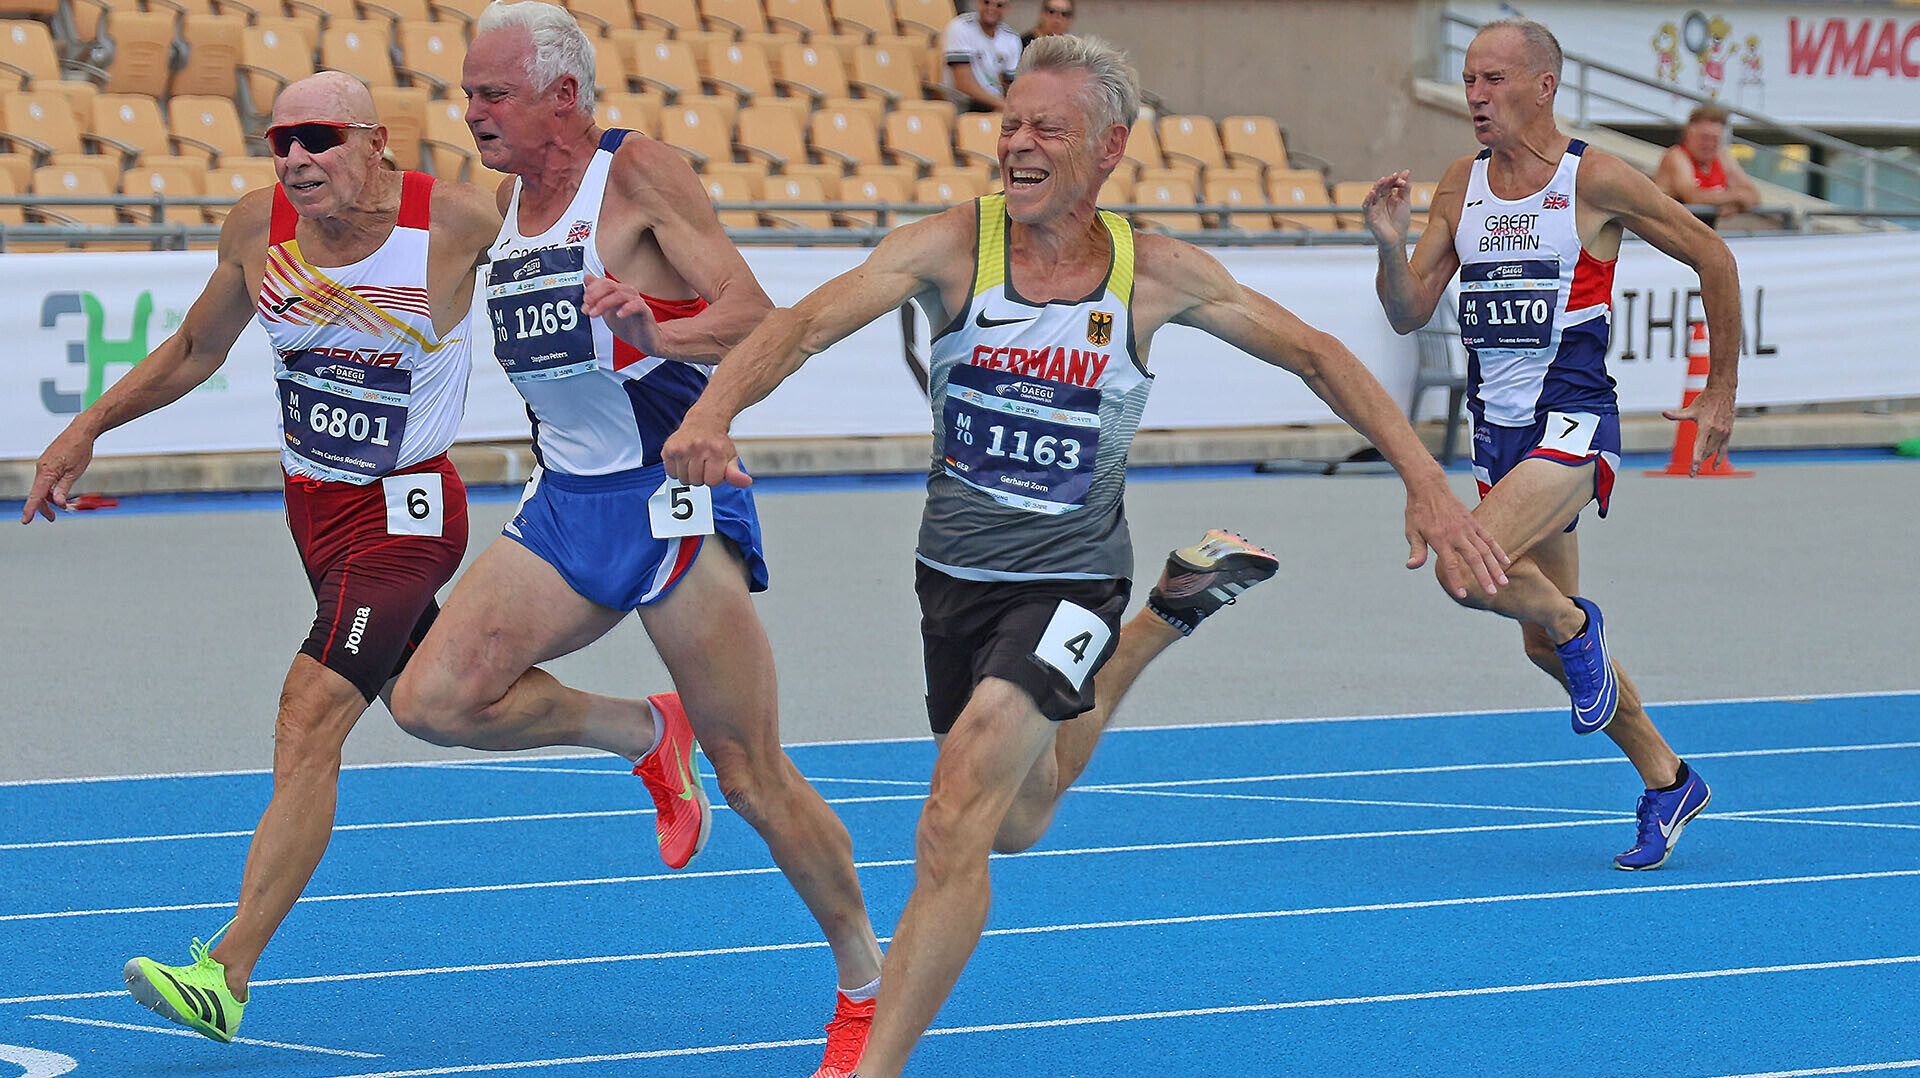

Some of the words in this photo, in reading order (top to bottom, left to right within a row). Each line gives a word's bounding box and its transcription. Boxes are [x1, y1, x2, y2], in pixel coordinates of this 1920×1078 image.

[1485, 214, 1539, 232] GREAT
[1479, 234, 1540, 252] BRITAIN
[1466, 299, 1477, 313] M
[1486, 299, 1548, 325] 1170
[515, 299, 578, 340] 1269
[1463, 313, 1479, 326] 70
[497, 326, 508, 342] 70
[336, 367, 365, 381] DAEGU
[970, 344, 1111, 388] GERMANY
[288, 391, 300, 408] M
[1021, 385, 1054, 399] DAEGU
[287, 405, 301, 423] 70
[956, 412, 972, 431] M
[309, 402, 390, 447] 6801
[1559, 416, 1580, 439] 7
[954, 426, 974, 446] 70
[985, 425, 1081, 470] 1163
[324, 452, 345, 463] Carlos
[955, 461, 970, 473] GER
[1000, 475, 1031, 488] Gerhard
[1031, 481, 1049, 493] Zorn
[406, 488, 430, 519] 6
[670, 486, 694, 521] 5
[344, 606, 373, 655] joma
[1063, 630, 1093, 665] 4
